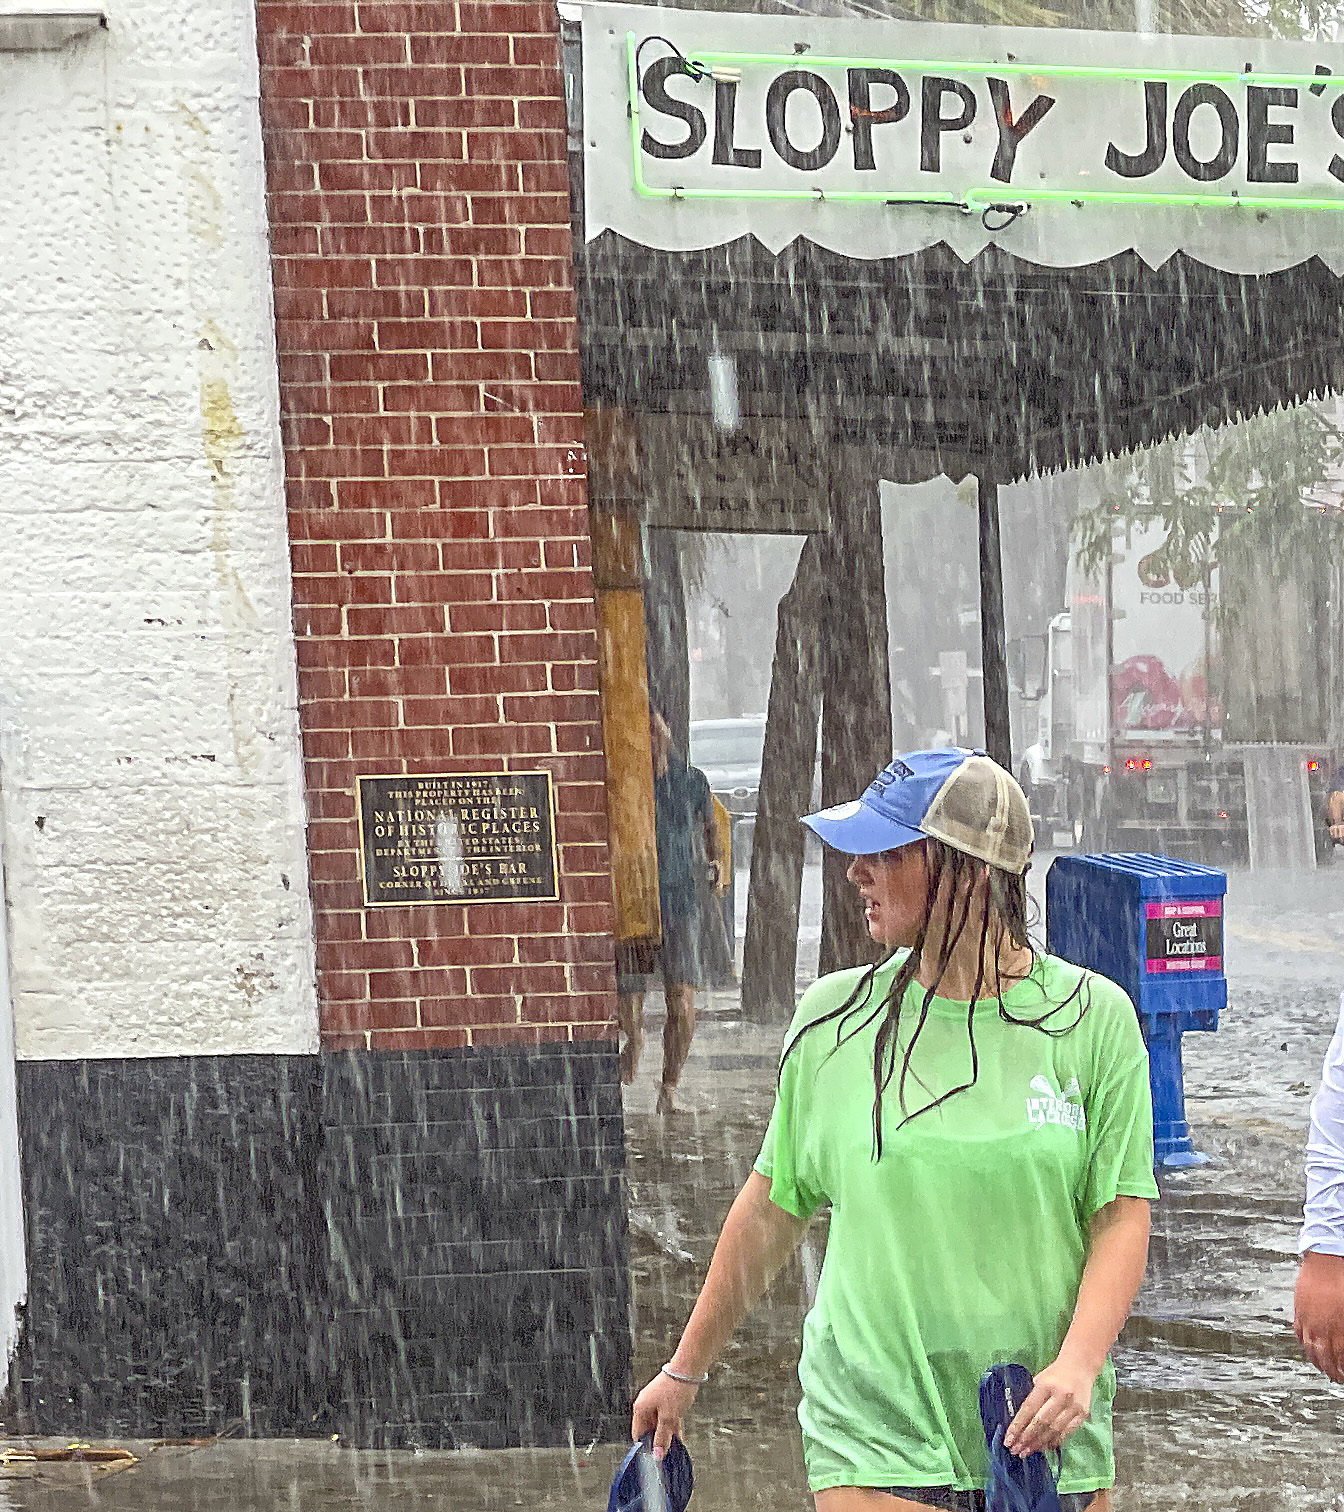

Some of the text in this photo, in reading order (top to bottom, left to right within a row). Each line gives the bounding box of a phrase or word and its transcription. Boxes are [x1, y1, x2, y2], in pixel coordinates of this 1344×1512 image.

[642, 56, 1056, 183] SLOPPY
[1140, 592, 1184, 605] FOOD
[417, 780, 449, 790] BUILT
[452, 780, 463, 789] IN
[388, 790, 413, 800] THIS
[415, 789, 470, 799] PROPERTY
[472, 788, 493, 798] HAS
[414, 795, 497, 806] PLACED ON THE
[374, 806, 540, 824] NATIONAL REGISTER
[375, 826, 395, 838] OF
[481, 820, 541, 835] PLACES
[398, 840, 412, 849] BY
[491, 843, 543, 853] INTERIOR
[499, 861, 528, 875] BAR
[1172, 921, 1198, 938] Great
[1165, 938, 1207, 955] Locations
